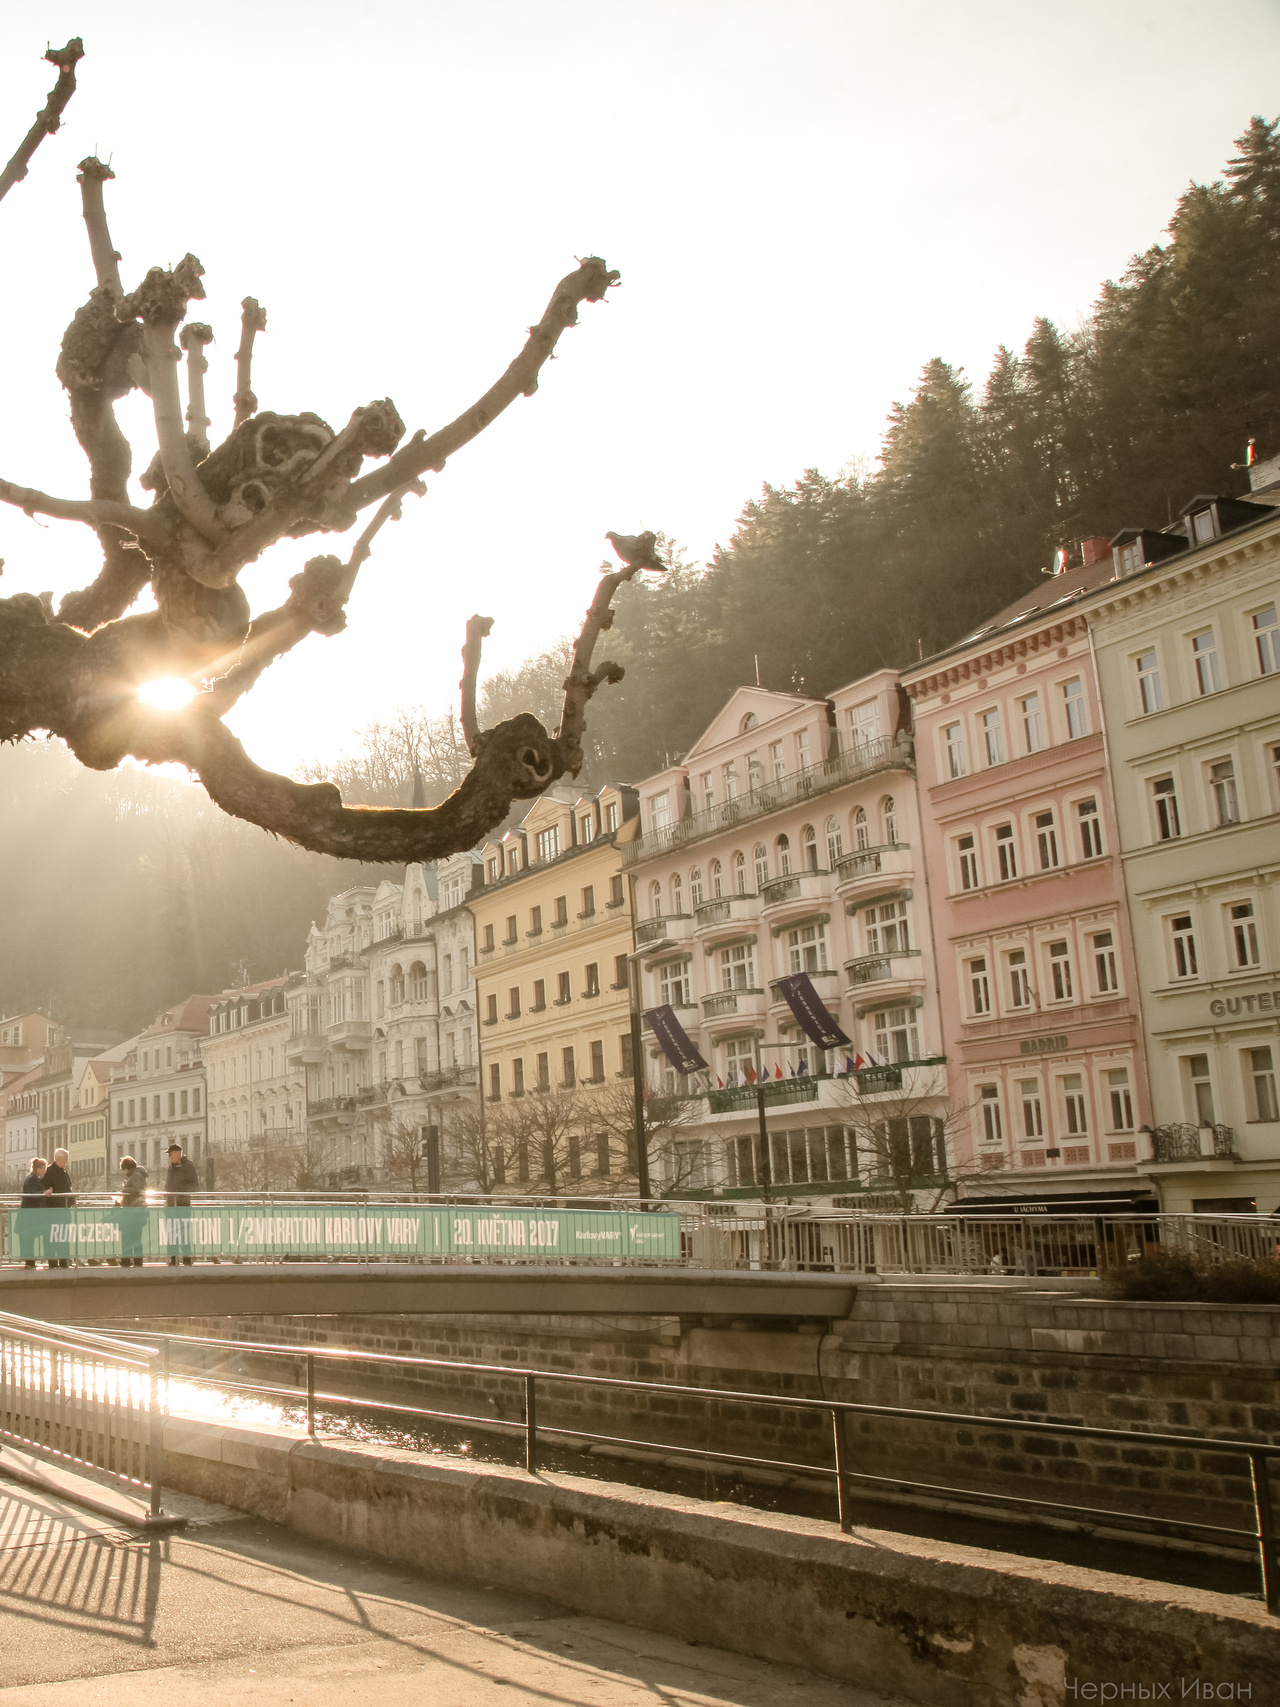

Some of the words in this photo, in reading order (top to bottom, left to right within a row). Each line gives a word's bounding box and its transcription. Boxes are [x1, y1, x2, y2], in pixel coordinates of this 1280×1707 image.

[1020, 1034, 1069, 1054] MADRID
[832, 1194, 915, 1209] RESTAURA
[158, 1217, 222, 1246] MATTONI
[324, 1217, 383, 1245] KARLOVY
[386, 1217, 420, 1245] VARY
[454, 1218, 474, 1246] 20.
[477, 1213, 526, 1246] KVĚTNA
[529, 1219, 559, 1247] 2017
